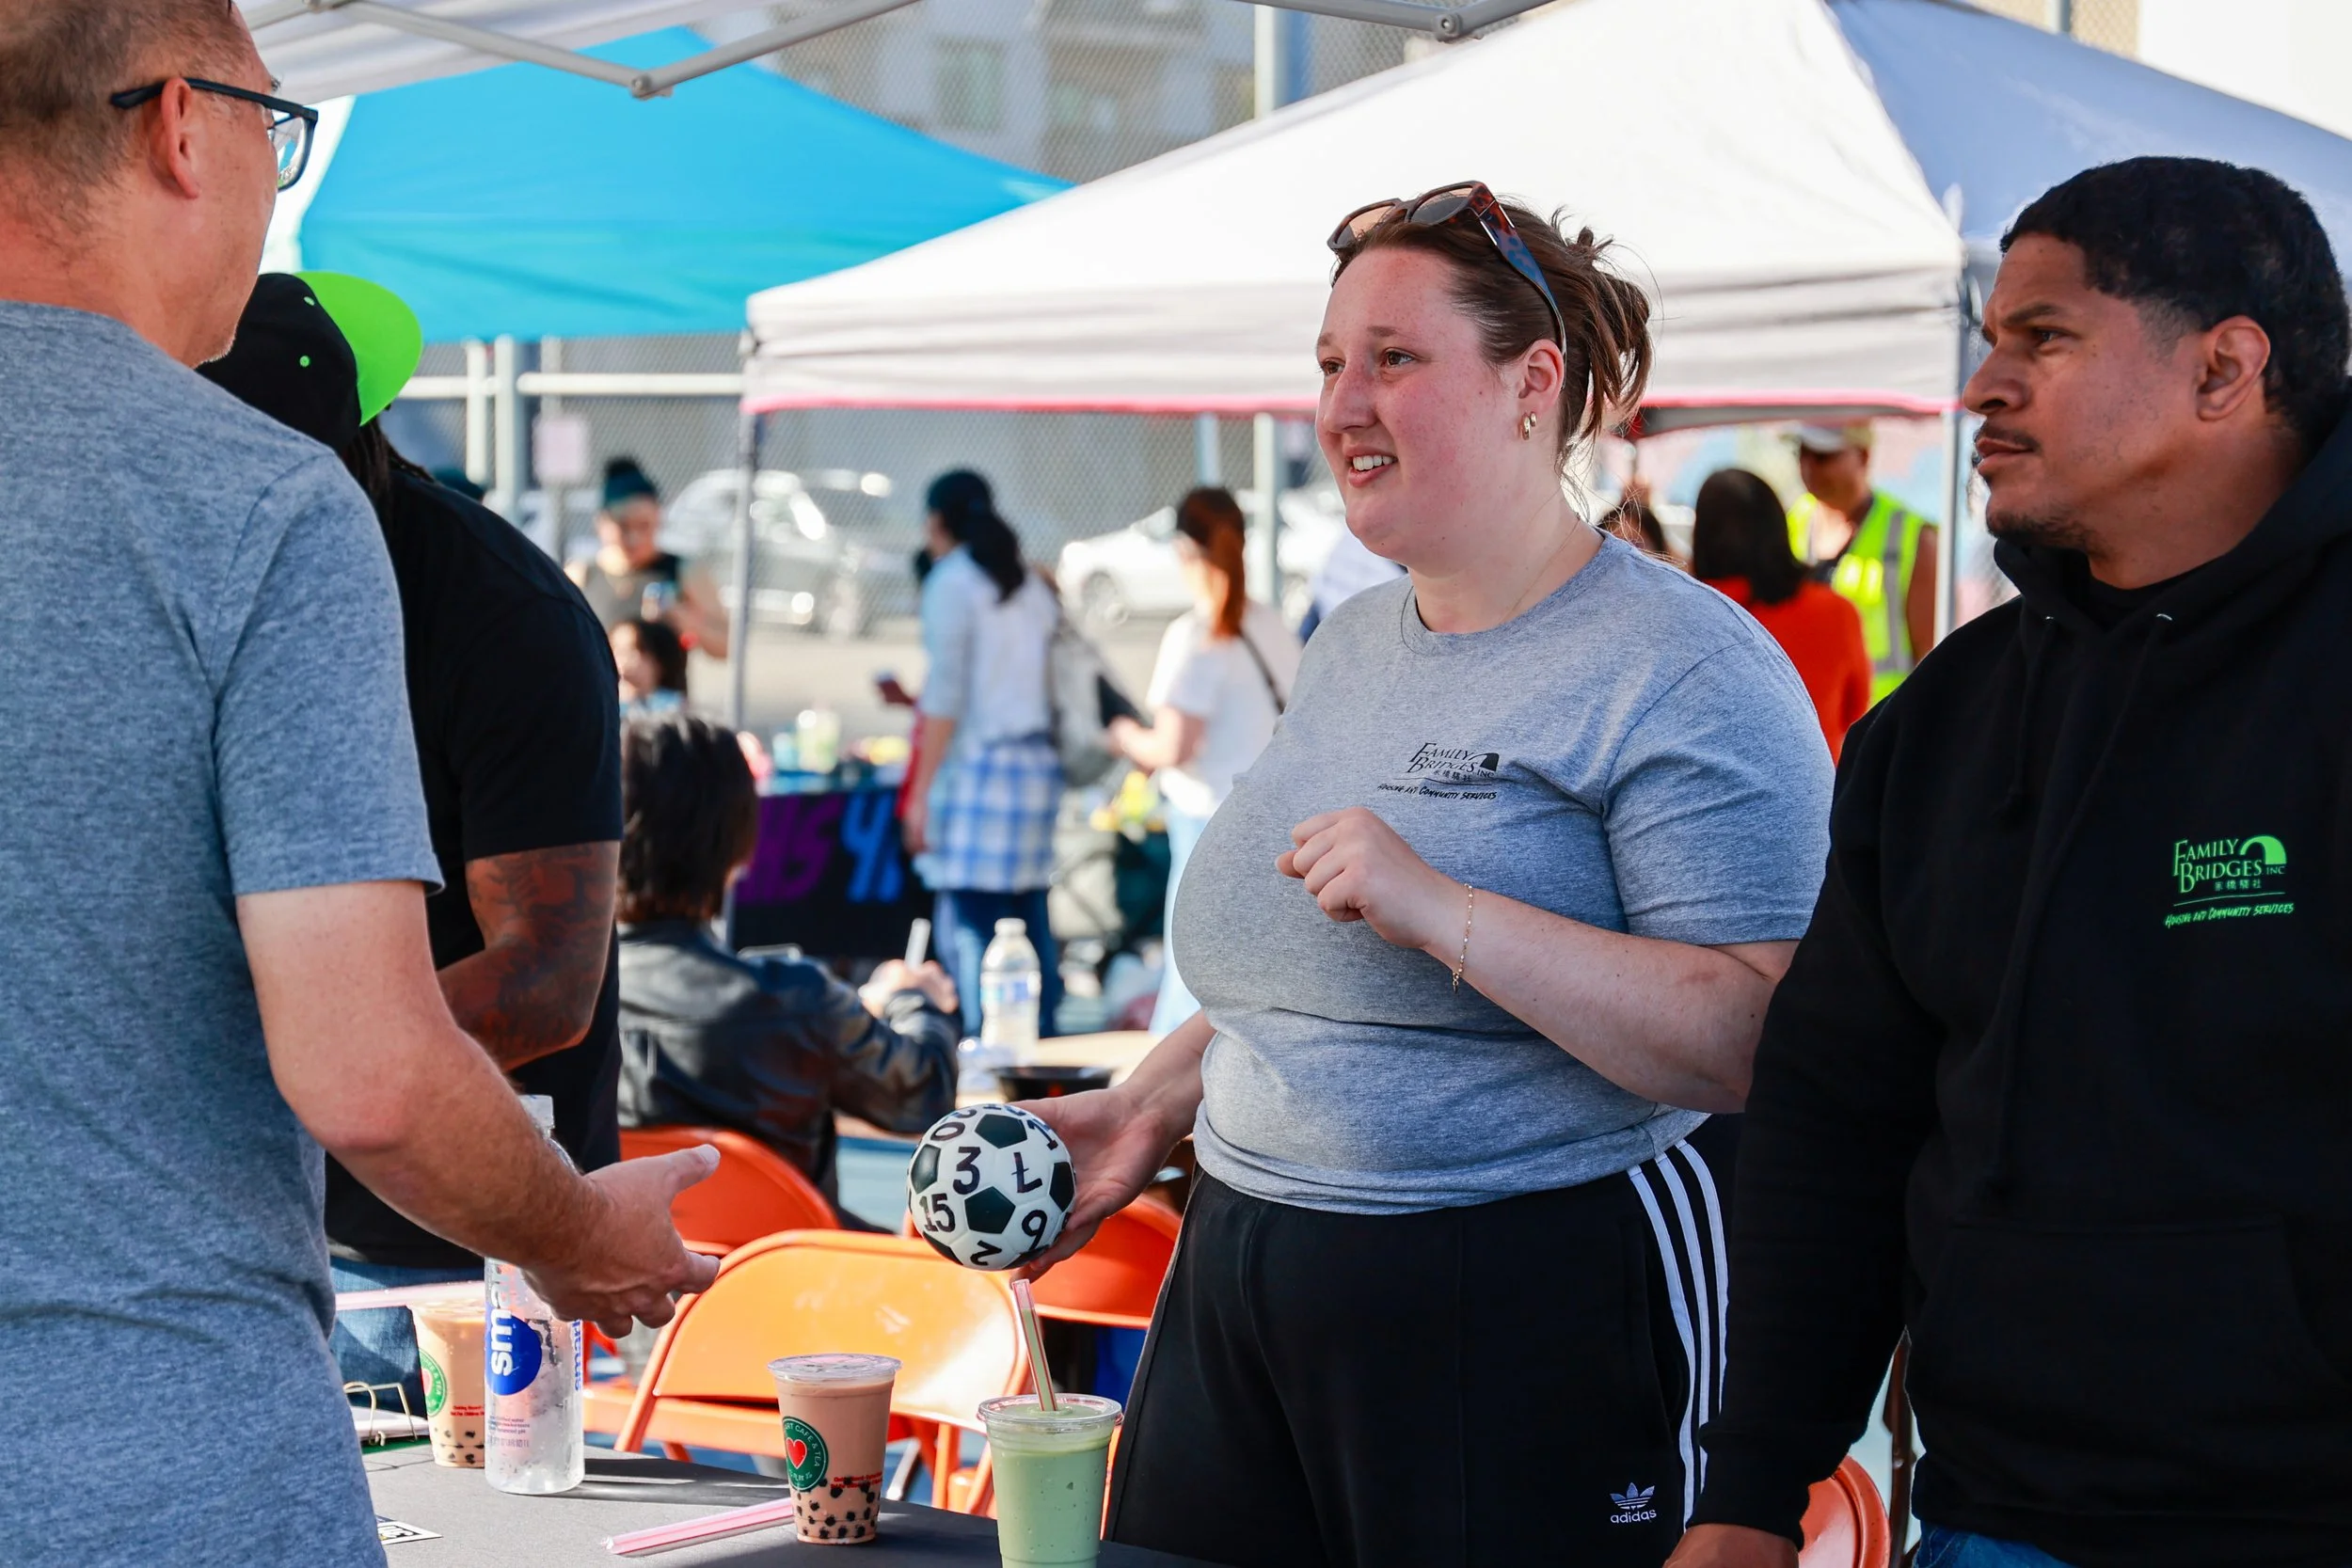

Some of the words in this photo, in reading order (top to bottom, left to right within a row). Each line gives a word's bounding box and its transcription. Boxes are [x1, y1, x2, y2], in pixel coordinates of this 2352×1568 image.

[2173, 838, 2239, 877] FAMILY
[2180, 860, 2263, 894] BRIDGES
[2266, 865, 2285, 875] INC
[952, 1147, 981, 1195] 3
[918, 1193, 956, 1232] 15
[795, 1424, 814, 1443] CAFE
[1610, 1509, 1657, 1524] adidas
